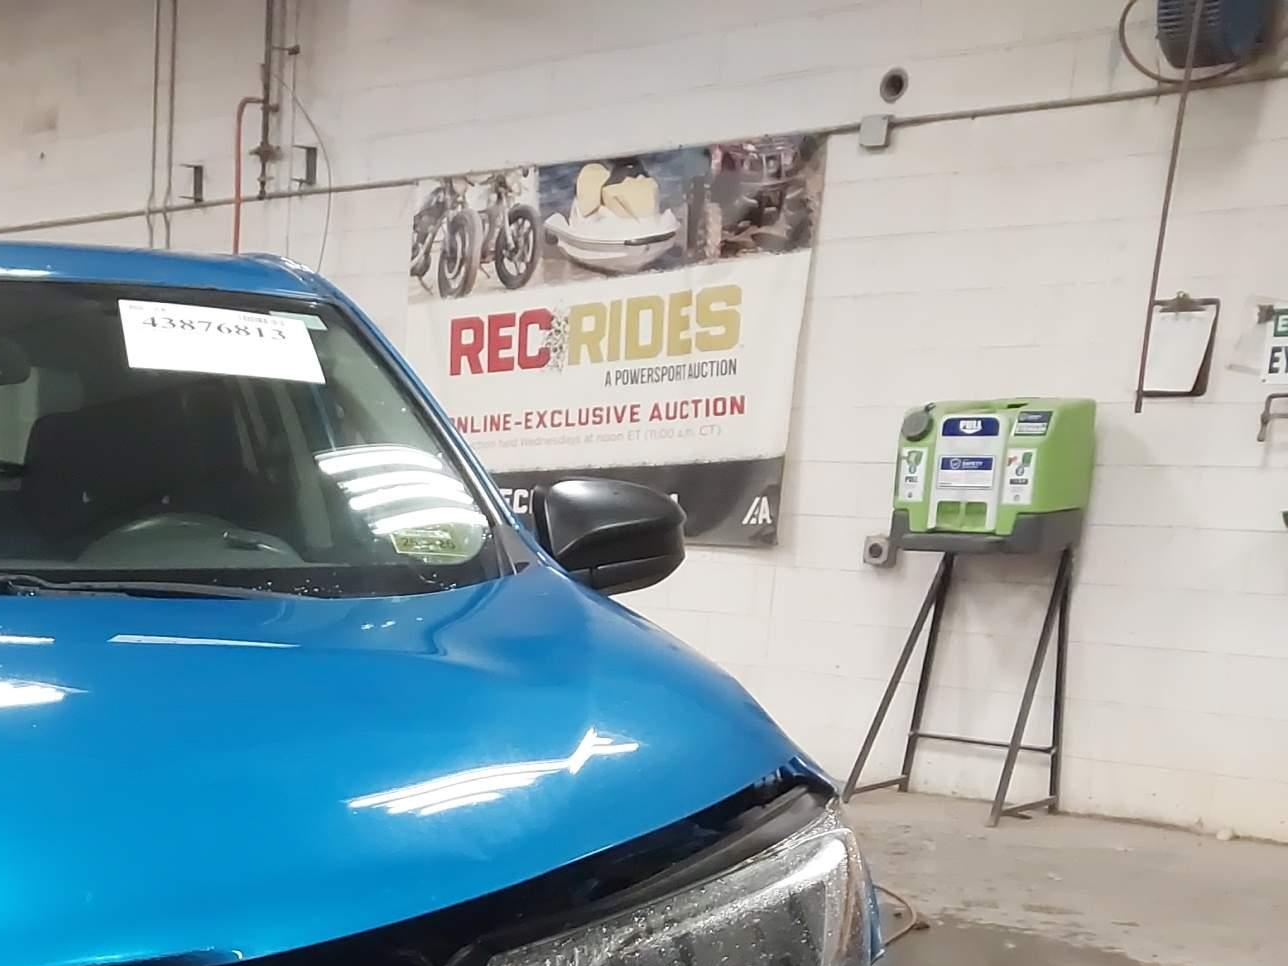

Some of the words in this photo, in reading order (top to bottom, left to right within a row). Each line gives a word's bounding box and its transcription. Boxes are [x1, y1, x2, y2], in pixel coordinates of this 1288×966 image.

[142, 316, 286, 340] 43876813
[450, 307, 553, 376] REC
[567, 284, 742, 366] RIDES
[605, 371, 612, 387] A
[615, 364, 686, 386] POWERSPORT
[687, 358, 738, 380] AUCTION
[450, 404, 641, 434] NLINE-EXCLUSIVE
[649, 395, 746, 421] AUCTION
